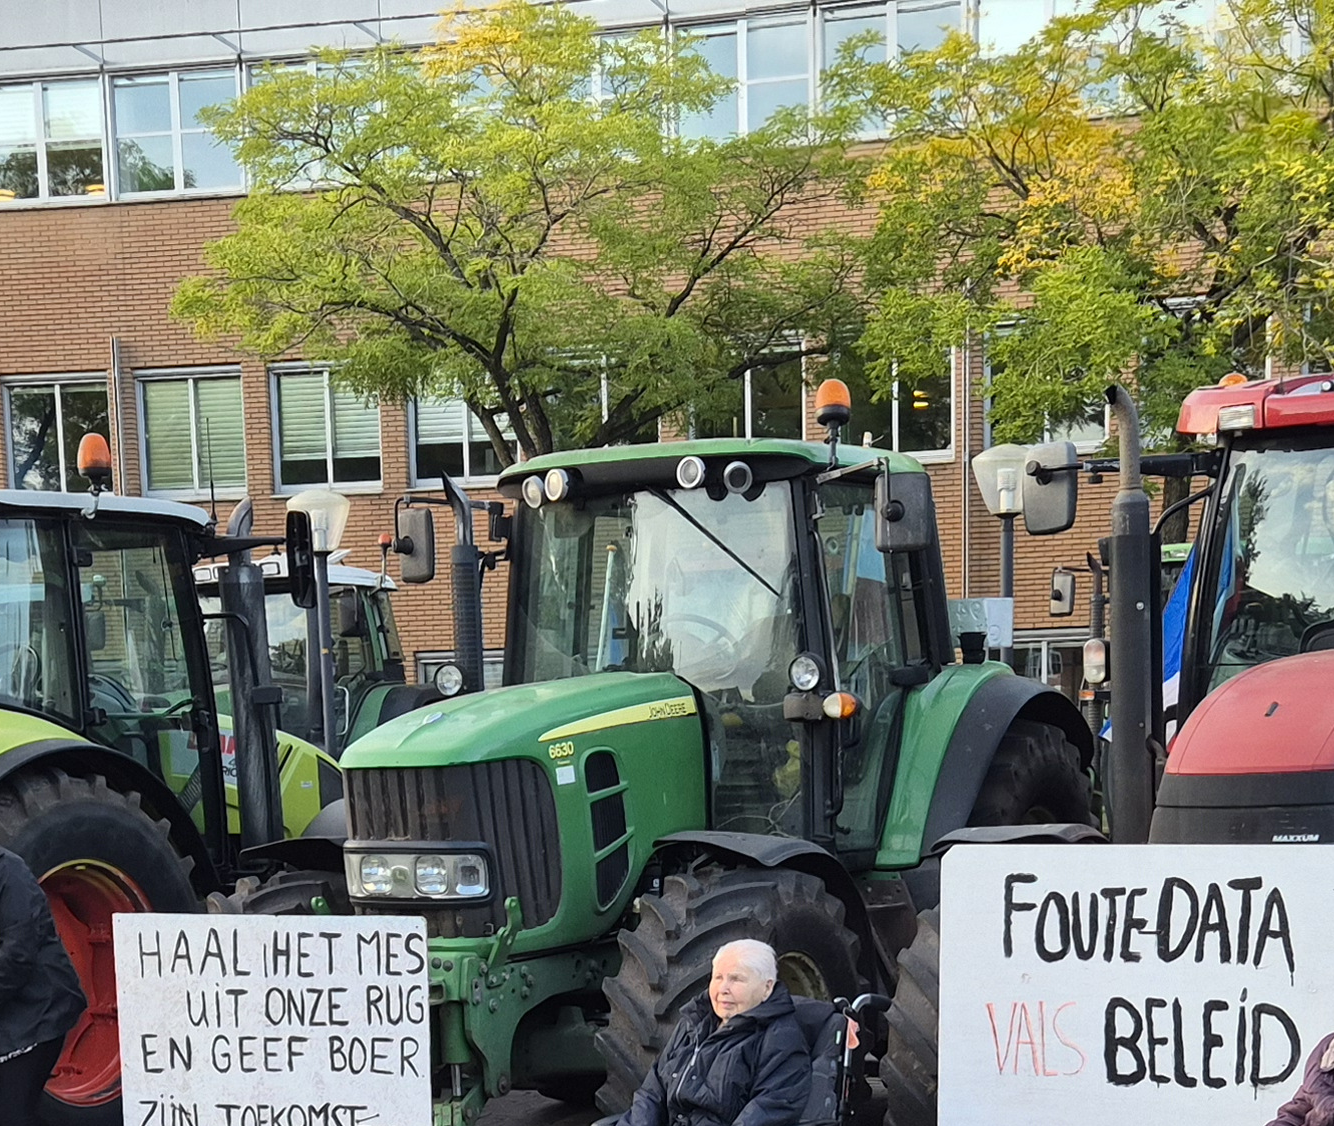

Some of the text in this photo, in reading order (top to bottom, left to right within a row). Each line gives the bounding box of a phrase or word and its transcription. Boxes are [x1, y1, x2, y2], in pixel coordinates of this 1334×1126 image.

[548, 741, 575, 759] 6630
[1272, 834, 1320, 842] MAXXUM
[138, 928, 251, 978] HAAL
[356, 931, 425, 976] MES
[265, 987, 350, 1027] ONZE
[366, 984, 425, 1027] RUG
[141, 1033, 192, 1073] EN
[212, 1034, 309, 1073] GEEF
[985, 1001, 1088, 1077] VALS
